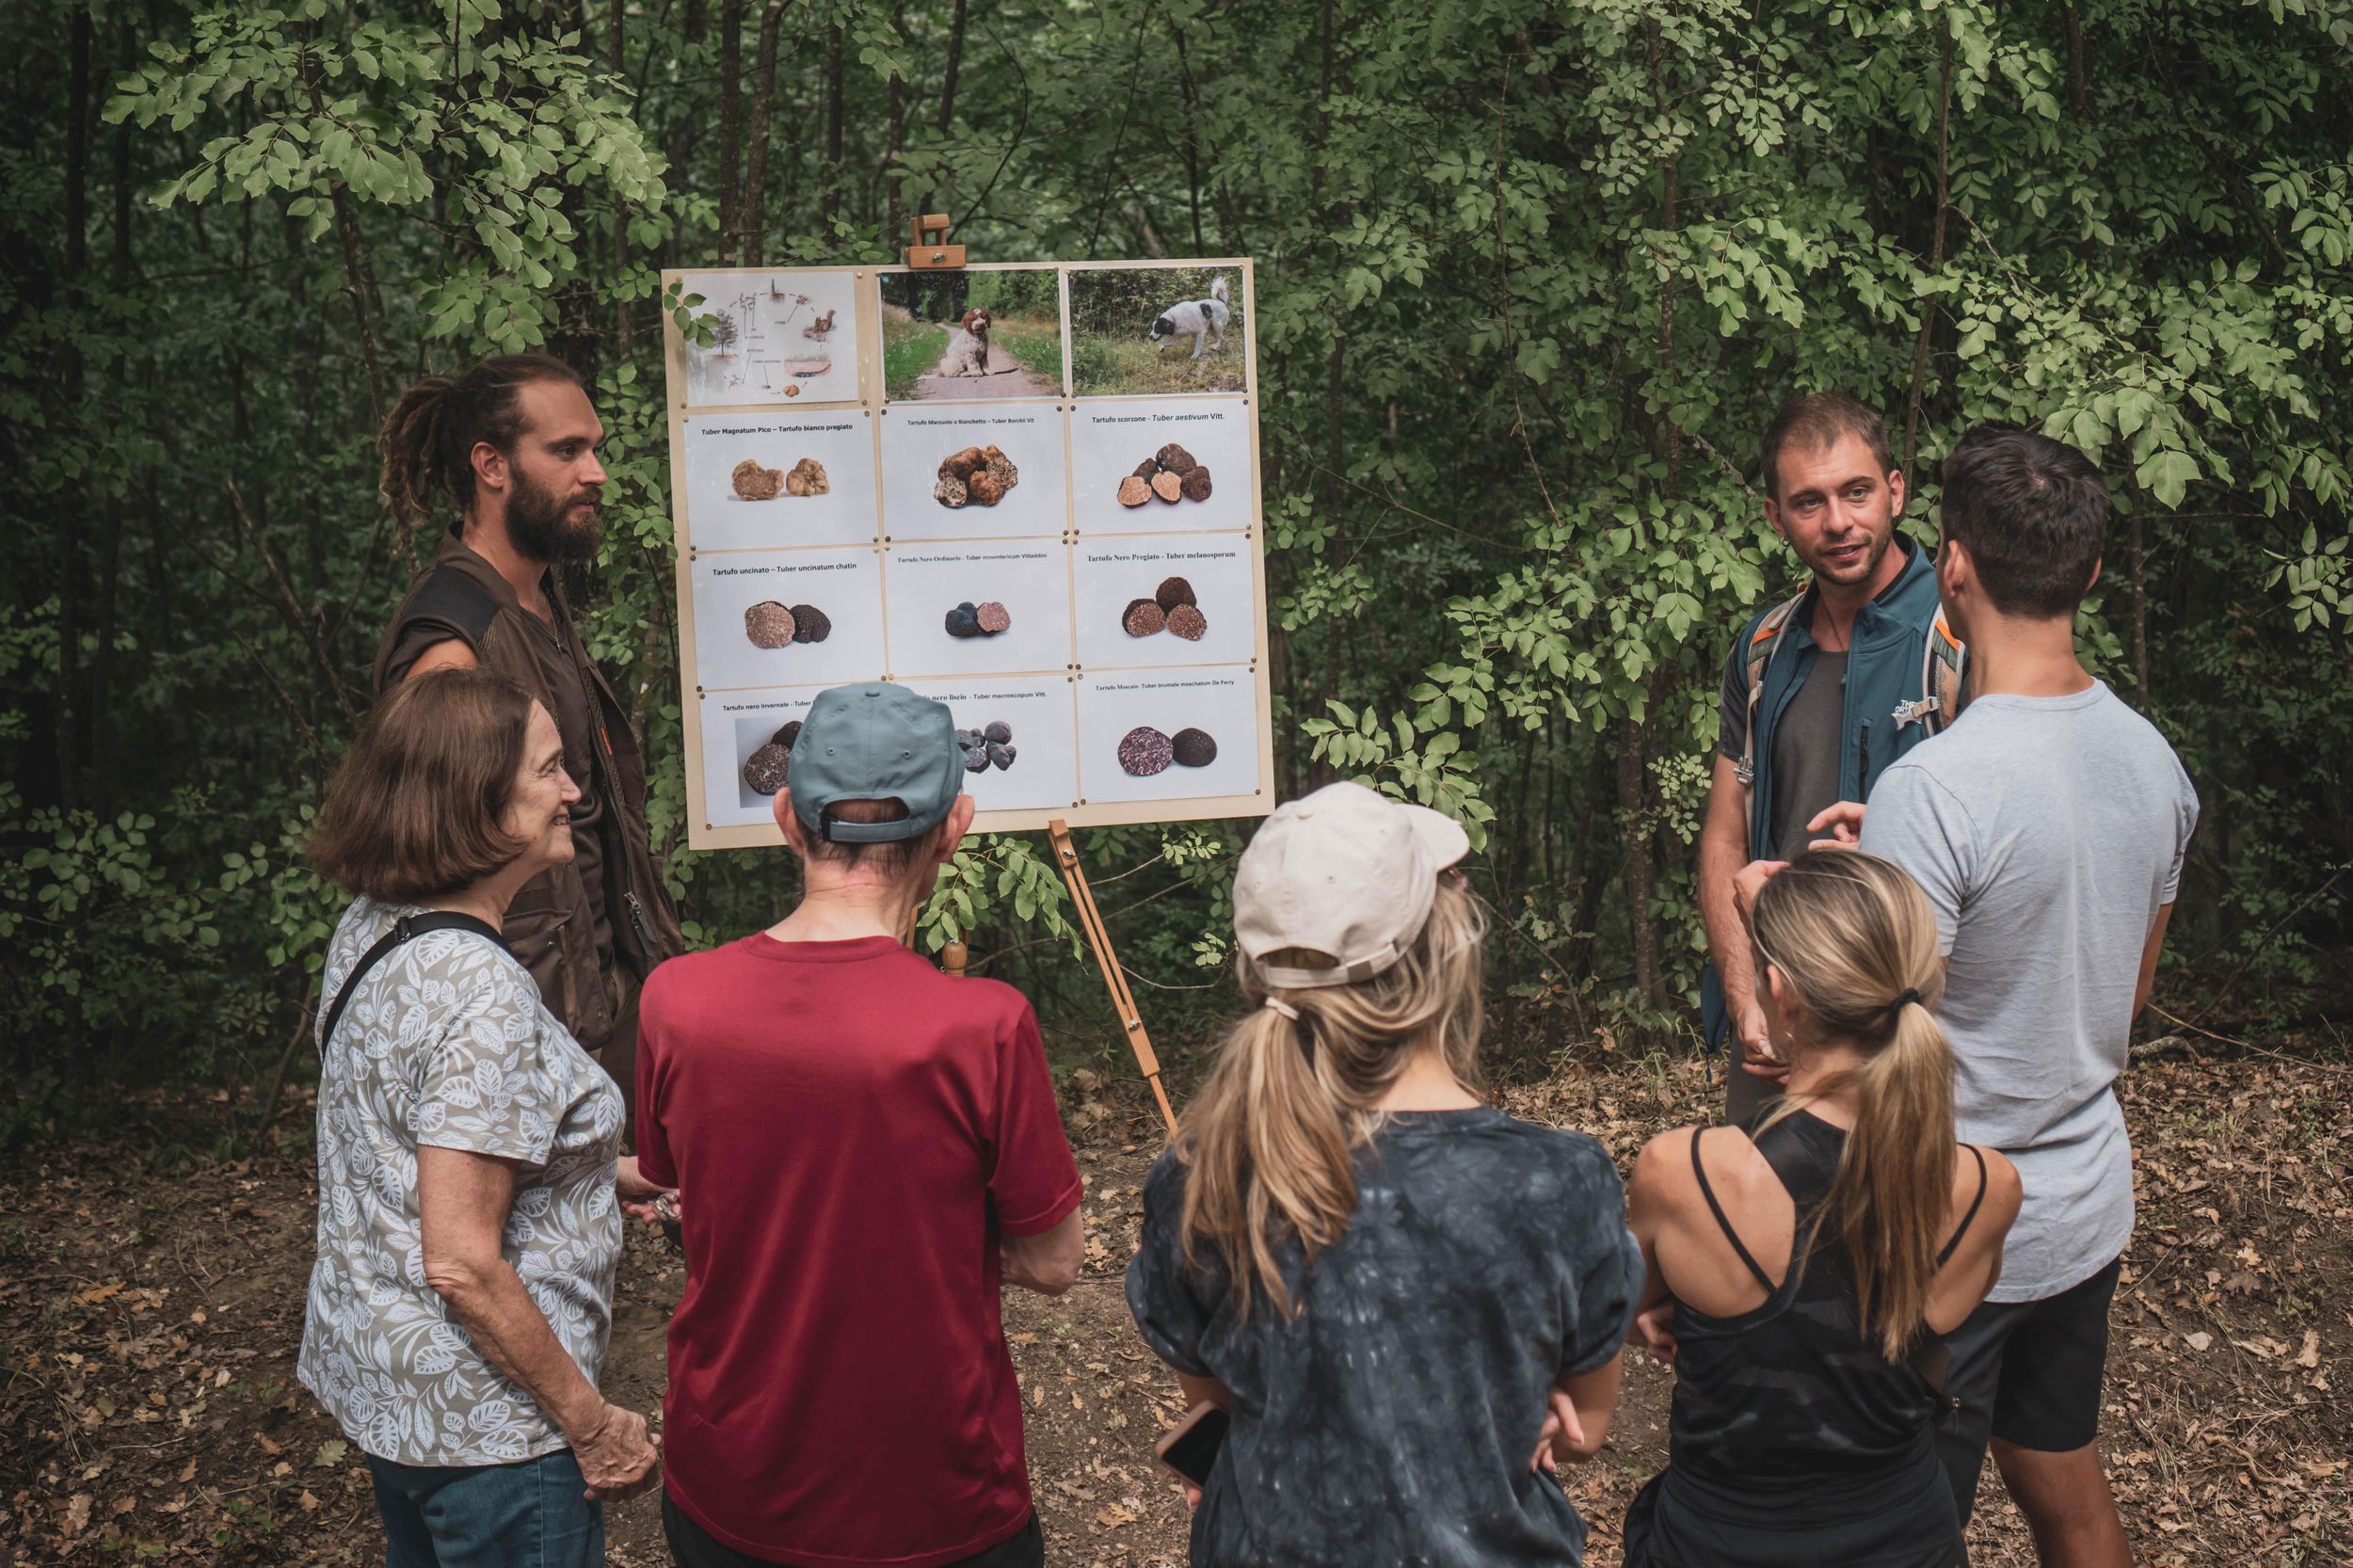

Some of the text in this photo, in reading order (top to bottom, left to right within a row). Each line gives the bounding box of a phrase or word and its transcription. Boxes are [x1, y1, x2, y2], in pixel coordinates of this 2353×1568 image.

[722, 427, 757, 436] Magnatum
[1131, 553, 1160, 562] Pregiato
[1186, 552, 1236, 560] melanosporum
